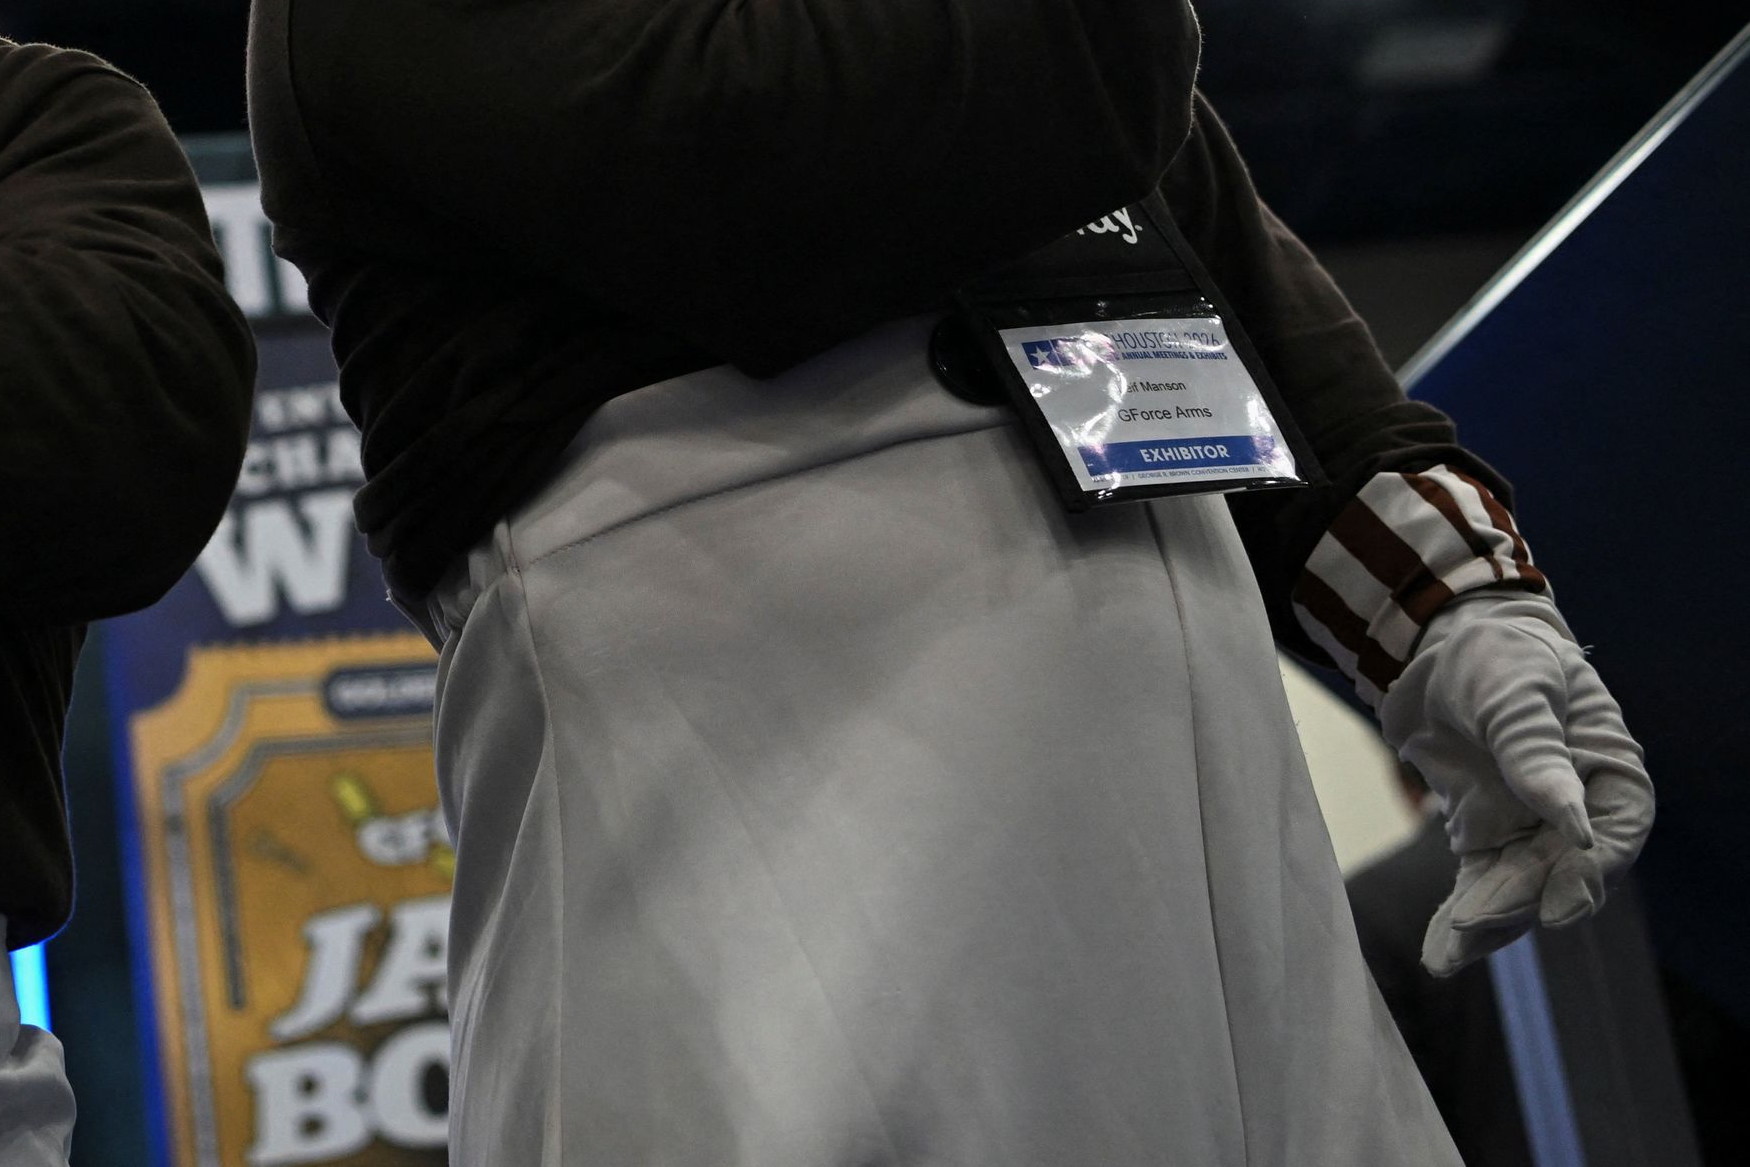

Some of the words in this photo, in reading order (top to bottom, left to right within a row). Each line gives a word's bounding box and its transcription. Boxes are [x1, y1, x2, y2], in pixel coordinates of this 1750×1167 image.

[1121, 351, 1154, 361] ANNUAL
[1153, 351, 1189, 360] MEETINGS
[1189, 350, 1196, 360] &
[1195, 351, 1228, 361] EXHIBITS
[1141, 380, 1187, 392] Manson
[1117, 407, 1172, 423] GForce
[1175, 405, 1213, 419] Arms
[1139, 444, 1231, 463] EXHIBITOR
